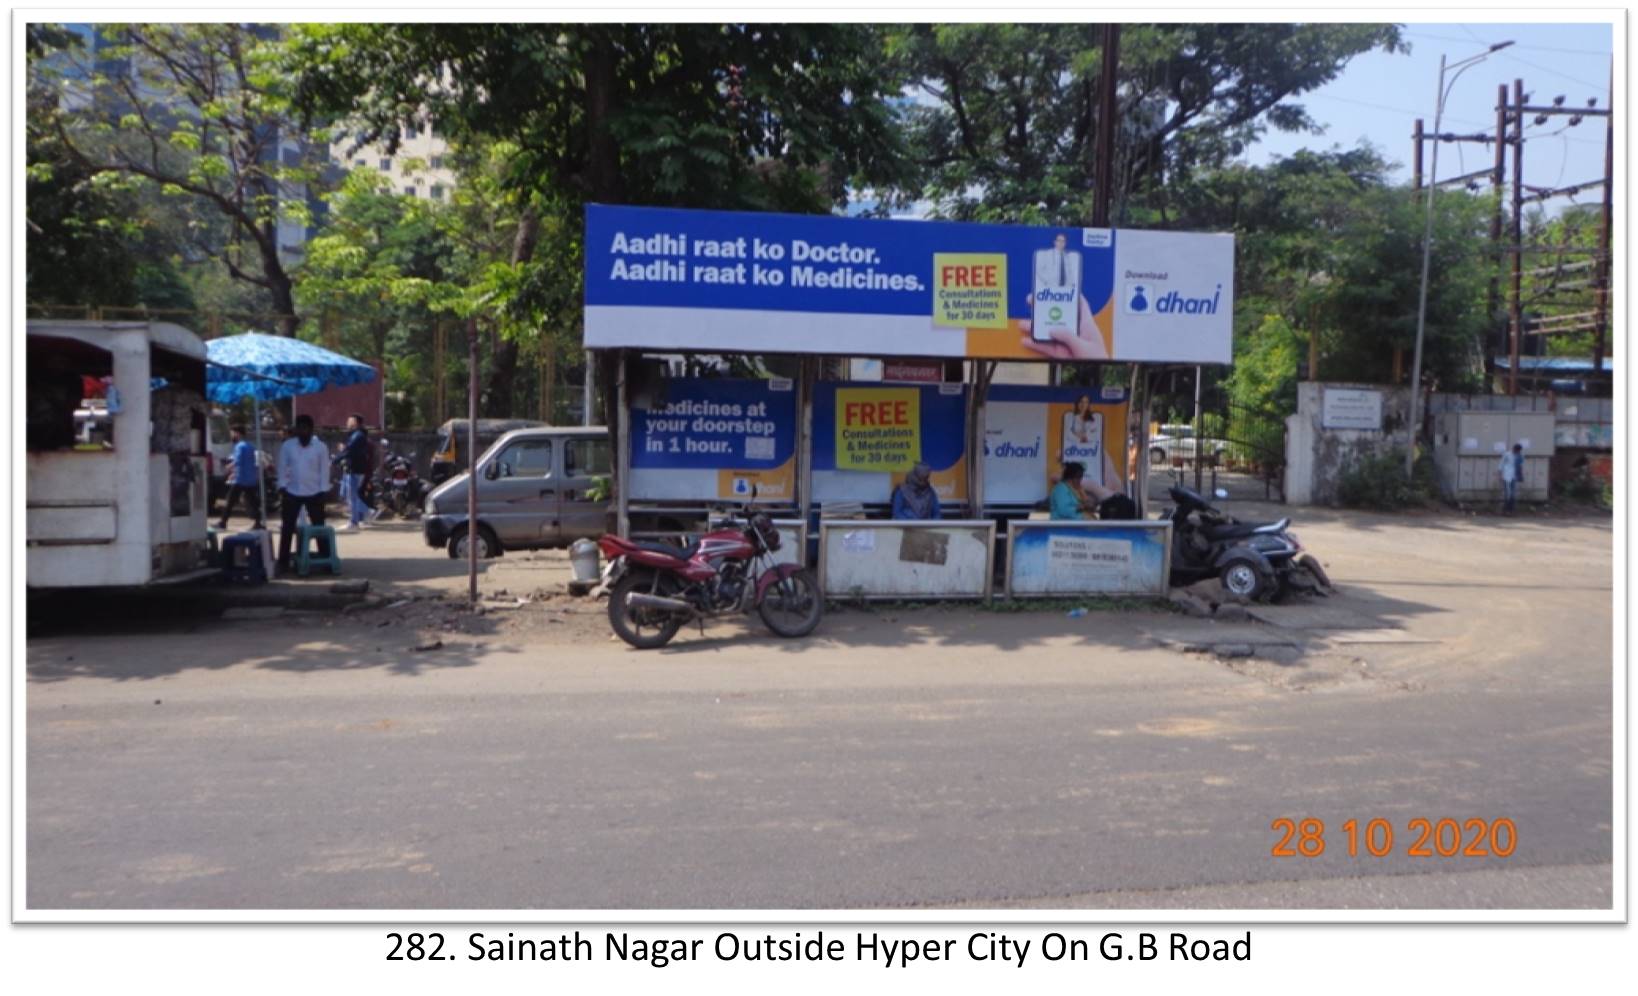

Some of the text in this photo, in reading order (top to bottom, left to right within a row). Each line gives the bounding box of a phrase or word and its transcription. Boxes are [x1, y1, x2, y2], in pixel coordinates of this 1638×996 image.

[610, 232, 881, 265] Aadhi raat ko Doctor.
[610, 258, 925, 292] Aadhi raat ko Medicines.
[941, 265, 998, 288] FREE
[1125, 270, 1168, 281] Download
[939, 287, 1001, 300] Consultations
[1036, 283, 1076, 303] dhani
[1155, 284, 1222, 315] dhani
[942, 300, 999, 311] & Medicines
[946, 310, 996, 323] for 30 days
[747, 402, 766, 417] at
[845, 400, 909, 426] FREE
[646, 417, 775, 436] your doorstep
[843, 428, 913, 440] Consultations
[646, 437, 732, 453] in 1 hour.
[847, 440, 911, 451] & Medicines
[995, 436, 1040, 458] dhani
[1064, 441, 1100, 458] dhani
[851, 452, 907, 466] for 30 days
